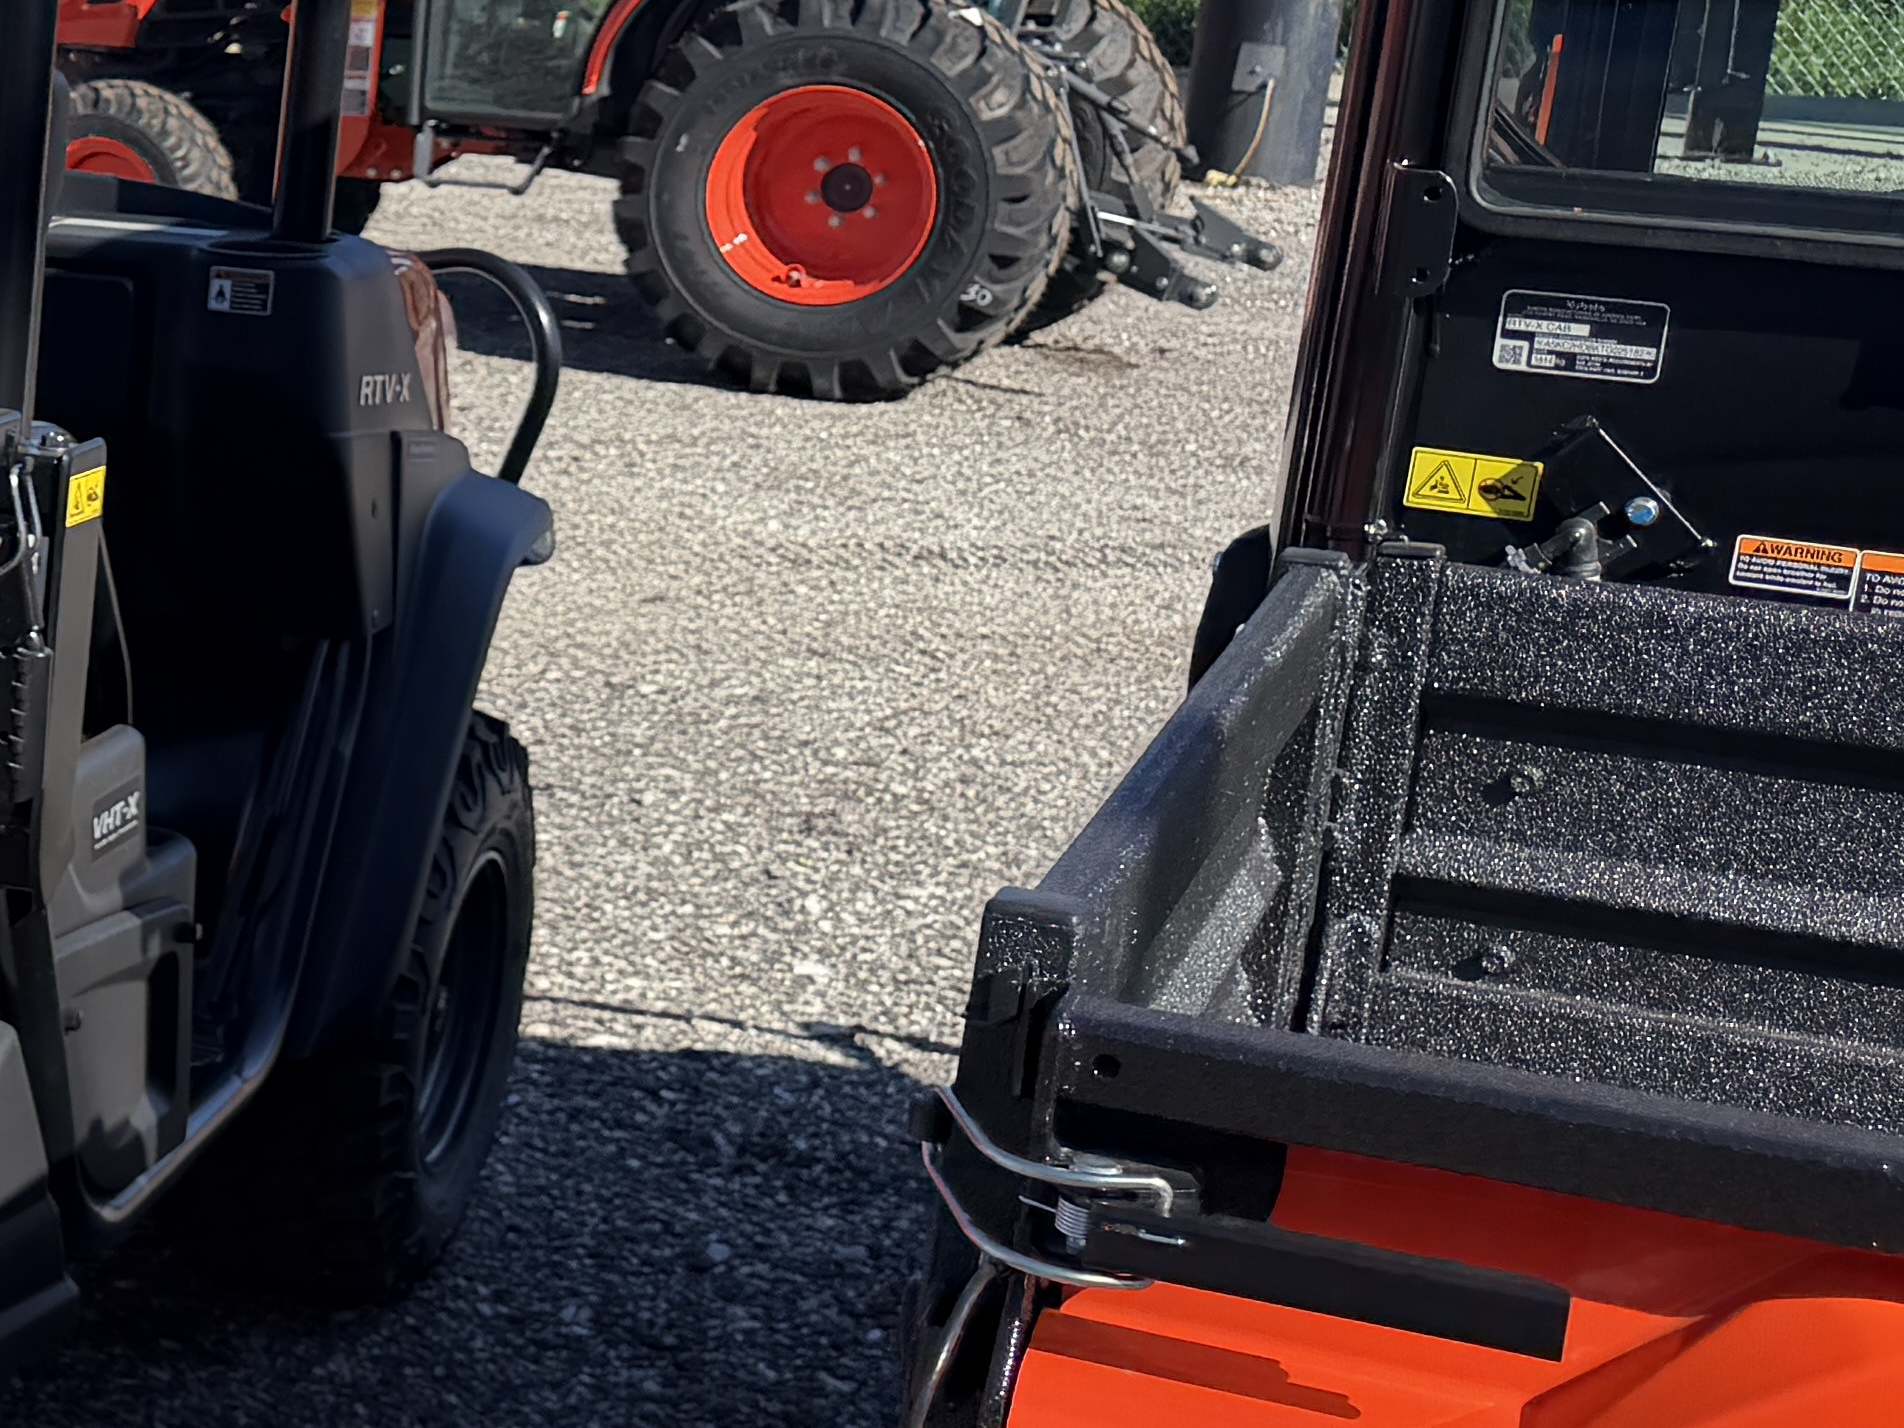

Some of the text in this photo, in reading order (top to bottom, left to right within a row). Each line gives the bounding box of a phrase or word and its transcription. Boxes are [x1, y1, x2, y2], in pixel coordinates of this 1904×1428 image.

[1546, 320, 1572, 333] CAB
[1770, 542, 1844, 564] WARNING
[1866, 573, 1880, 584] TO
[1874, 585, 1890, 595] Do
[1872, 596, 1889, 606] Do
[93, 790, 140, 840] VHT-X
